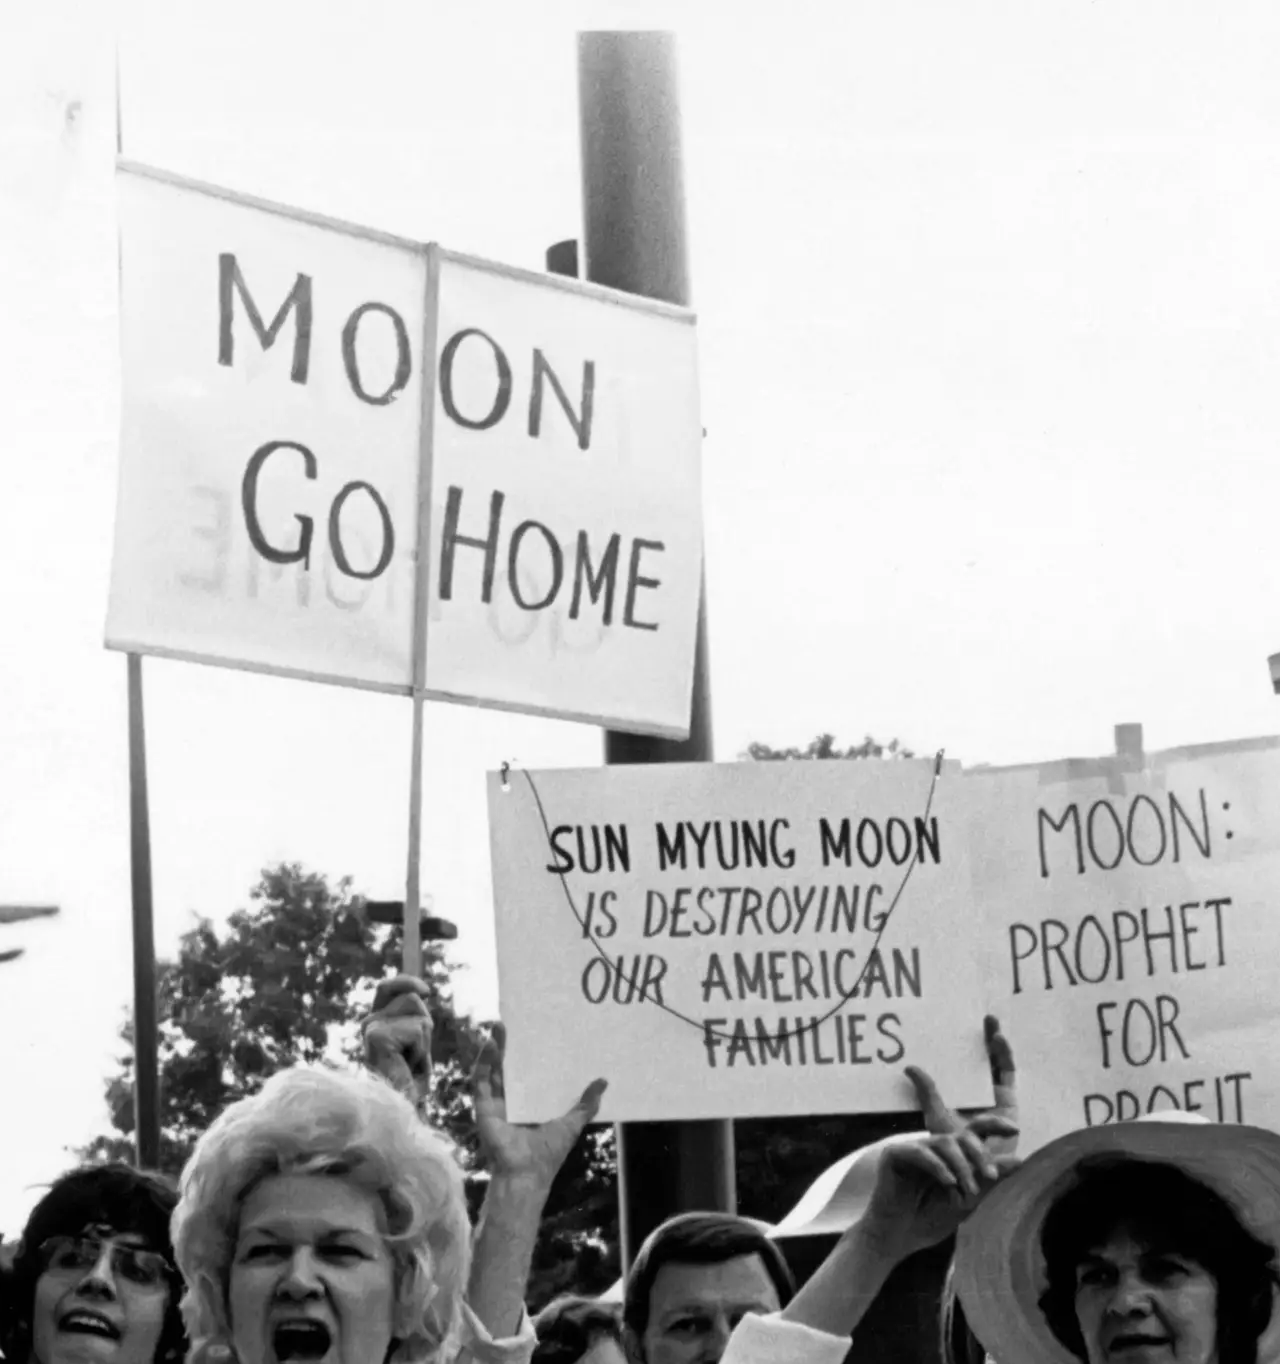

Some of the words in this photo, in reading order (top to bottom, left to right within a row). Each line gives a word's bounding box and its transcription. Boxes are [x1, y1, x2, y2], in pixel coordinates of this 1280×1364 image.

[218, 252, 595, 450] MOON
[241, 440, 396, 580] GO
[438, 485, 666, 632] HOME
[546, 822, 631, 874] SUN
[656, 817, 796, 872] MYUNG
[820, 816, 942, 867] MOON
[1038, 787, 1235, 877] MOON:
[582, 889, 618, 939] IS
[644, 884, 889, 938] DESTROYING
[1009, 898, 1233, 994] PROPHET
[582, 955, 668, 1004] OUR
[701, 947, 922, 1002] AMERICAN
[703, 1013, 906, 1068] FAMILIES
[1096, 995, 1191, 1069] FOR
